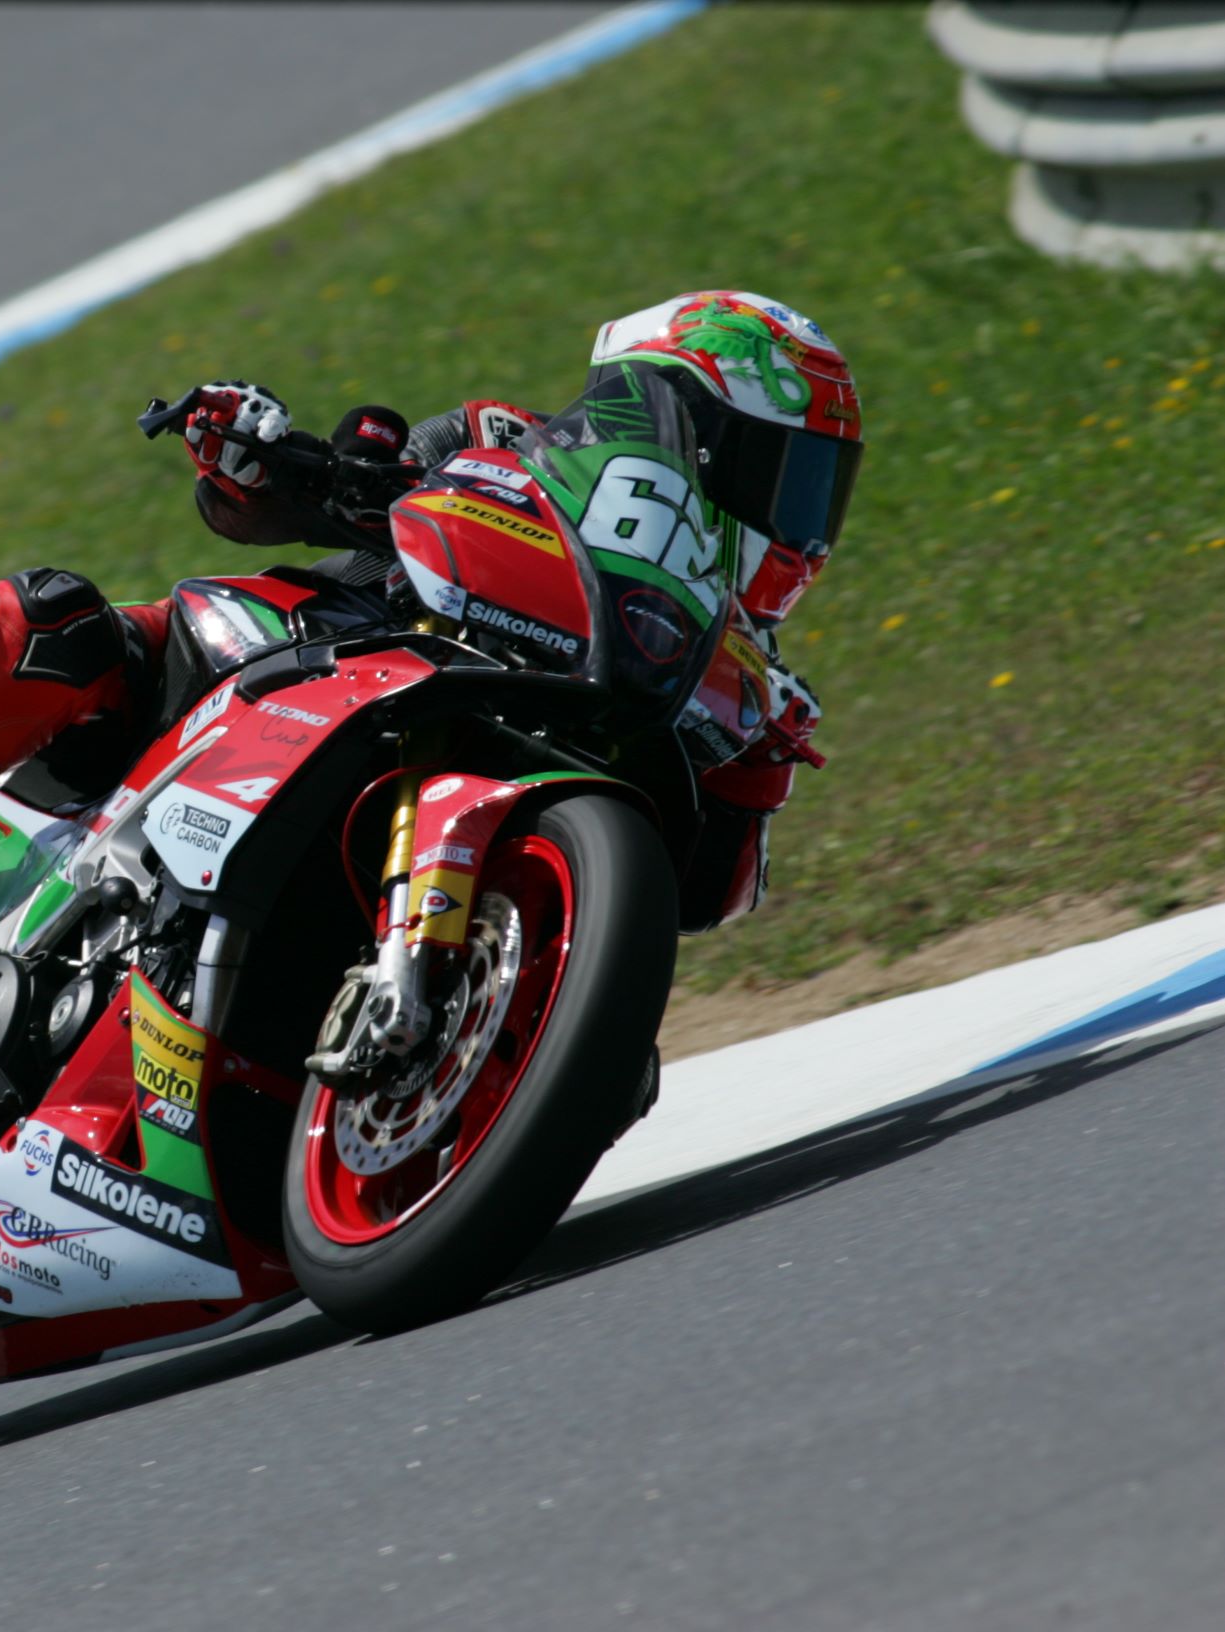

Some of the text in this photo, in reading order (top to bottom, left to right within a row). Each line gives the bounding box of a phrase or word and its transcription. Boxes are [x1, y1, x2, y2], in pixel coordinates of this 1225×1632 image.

[461, 504, 555, 542] DUNLOP
[466, 601, 578, 654] Silkolene
[257, 701, 331, 727] TUONO
[184, 808, 227, 834] TECHNO
[177, 827, 221, 854] CARBON
[140, 1018, 205, 1062] DUNLOP
[136, 1057, 194, 1101] moto
[19, 1139, 54, 1167] FUCHS
[57, 1152, 207, 1244] Silkolene
